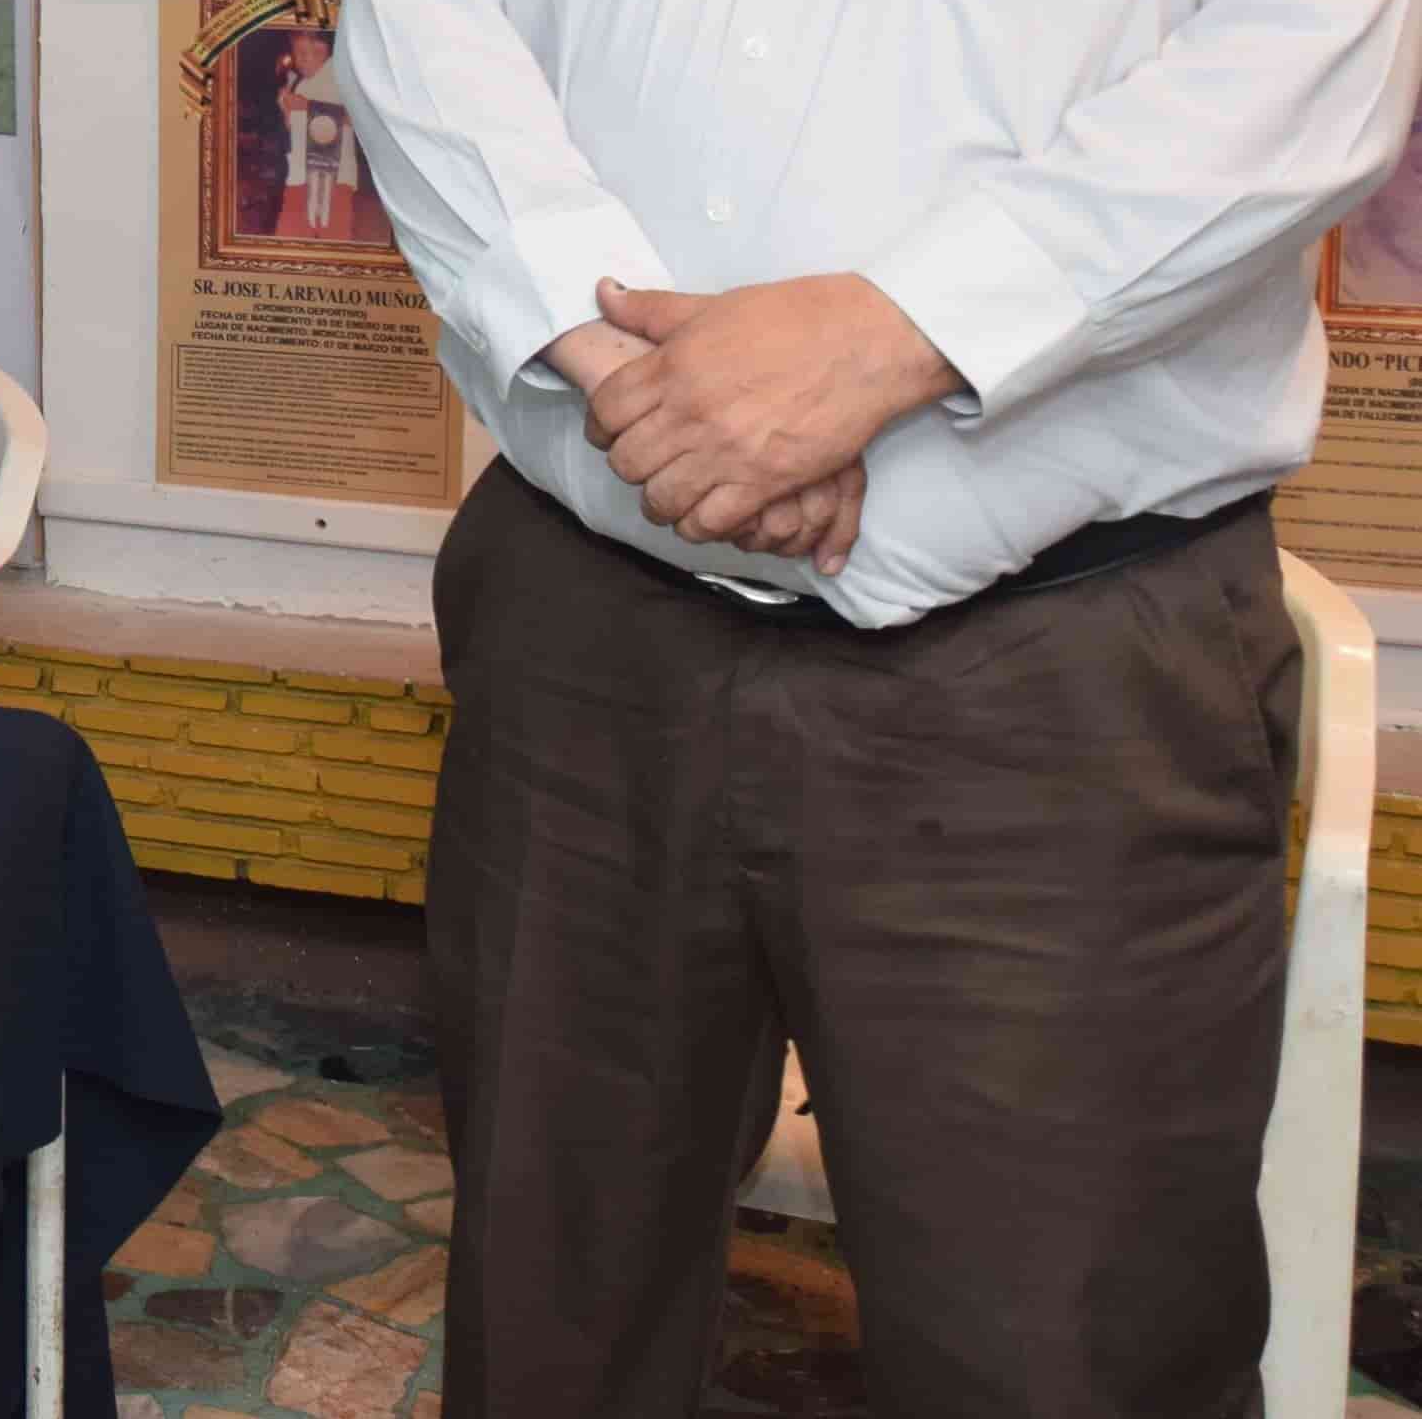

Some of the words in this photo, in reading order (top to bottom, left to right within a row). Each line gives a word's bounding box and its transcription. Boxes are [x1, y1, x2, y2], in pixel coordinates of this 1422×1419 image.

[194, 280, 217, 295] SR.
[223, 281, 260, 297] JOSE
[284, 287, 361, 306] AREVALO
